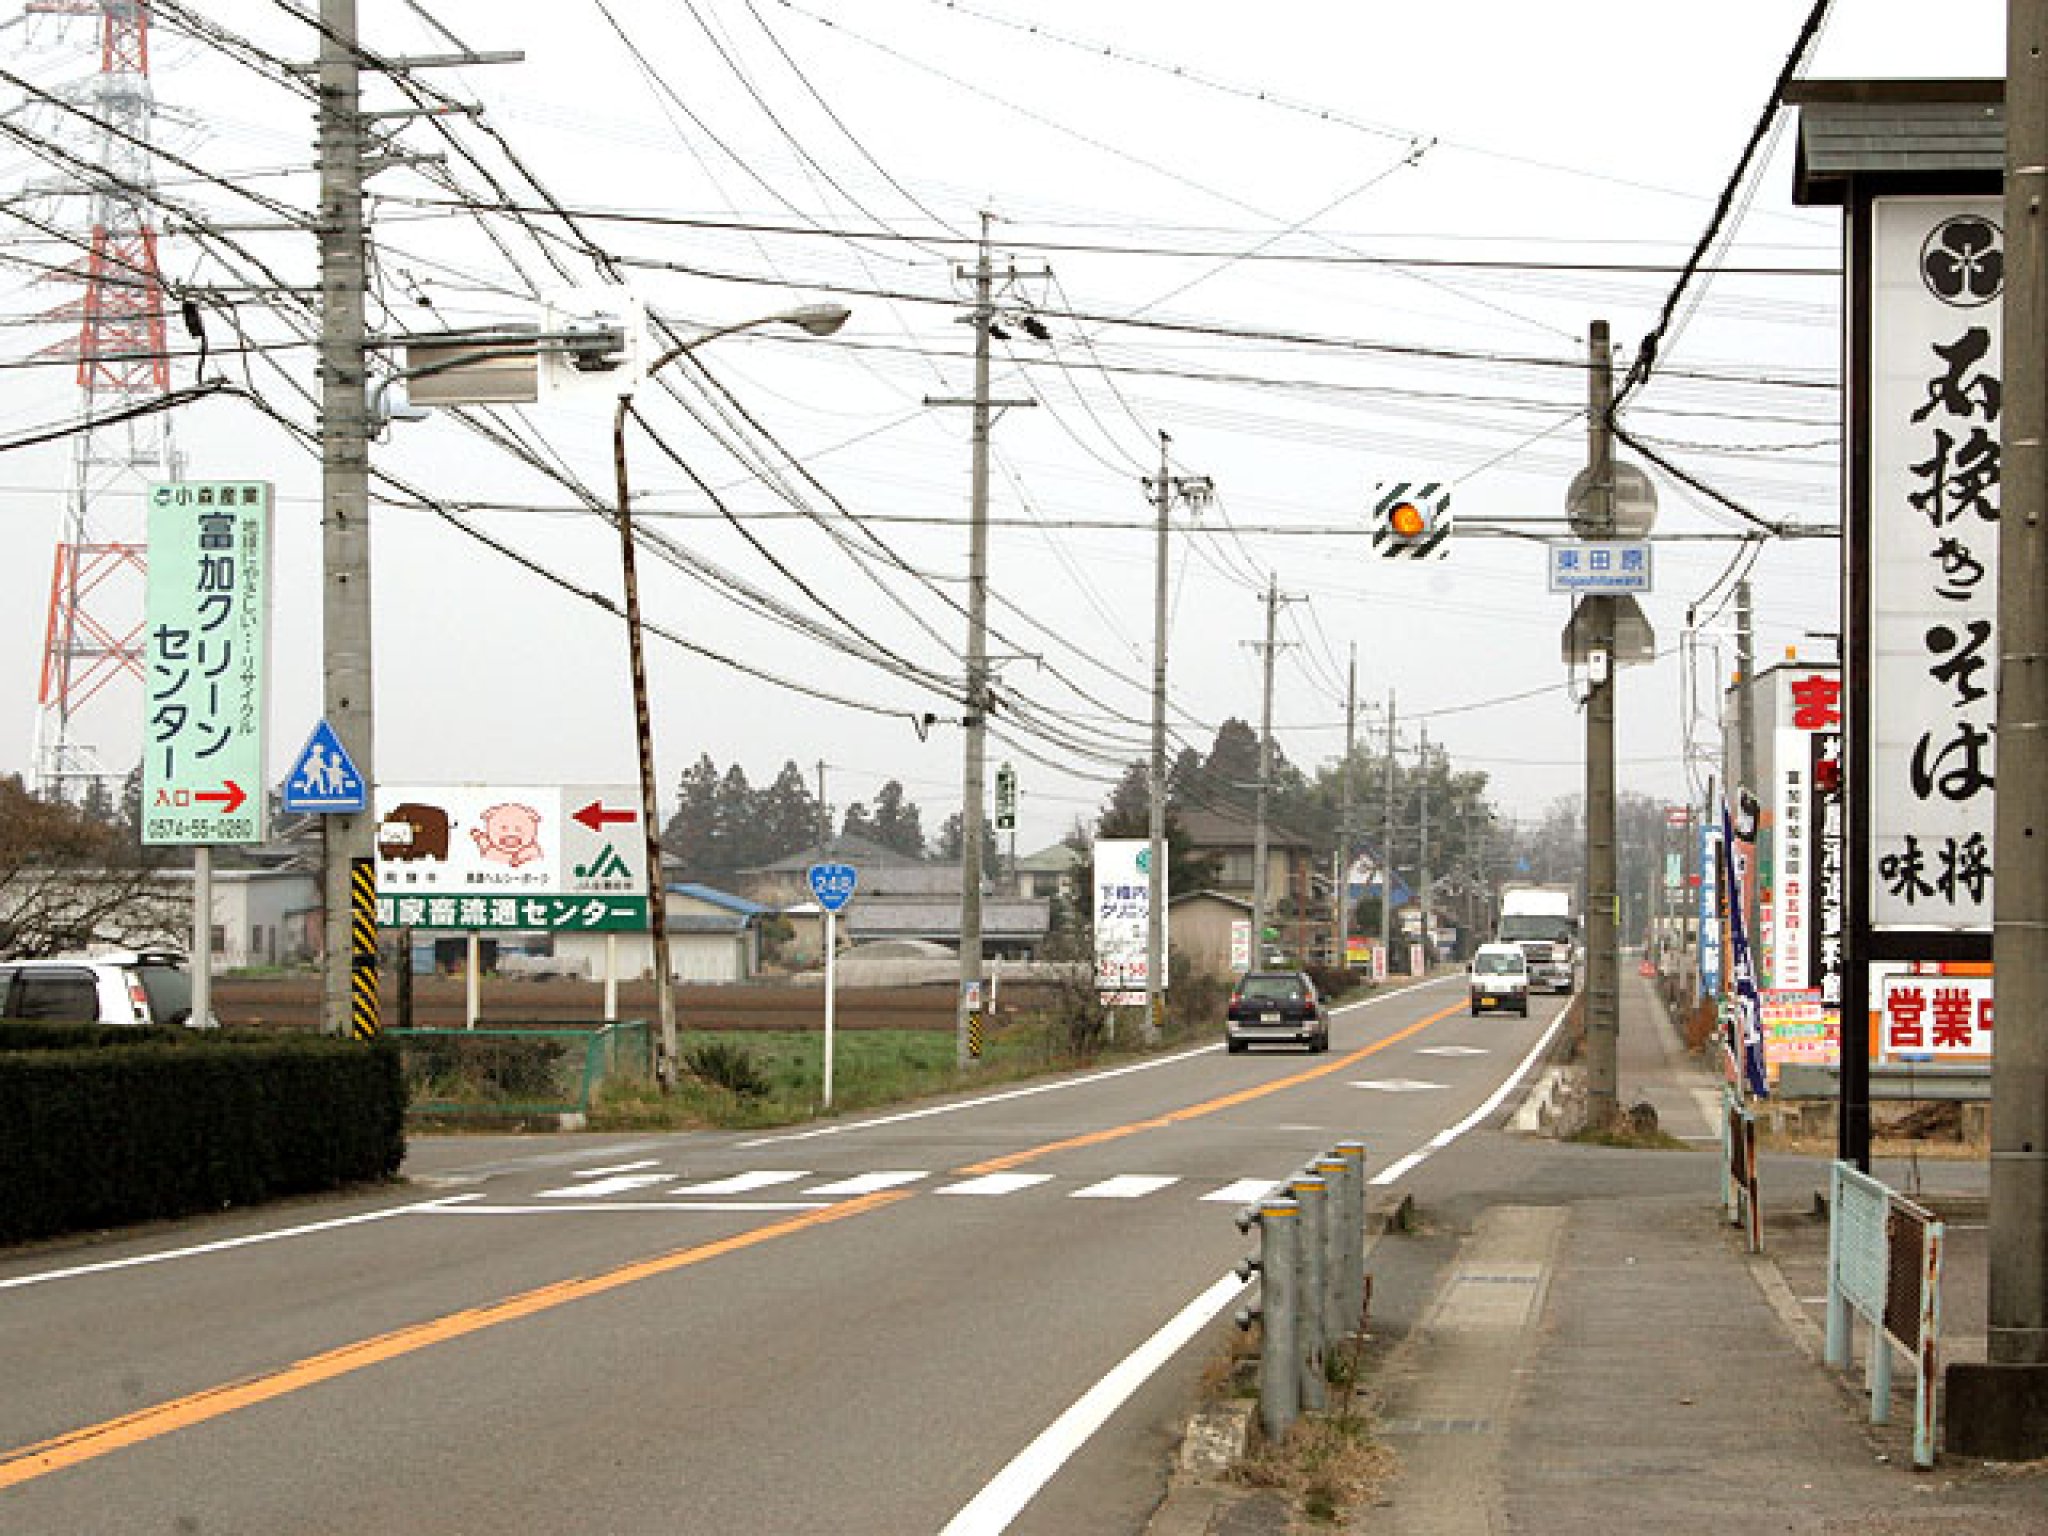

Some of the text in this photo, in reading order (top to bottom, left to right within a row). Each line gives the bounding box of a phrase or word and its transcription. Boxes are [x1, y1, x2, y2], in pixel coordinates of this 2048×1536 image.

[151, 624, 190, 781] センター
[196, 512, 235, 758] 富加クリーン
[154, 788, 190, 807] 入口
